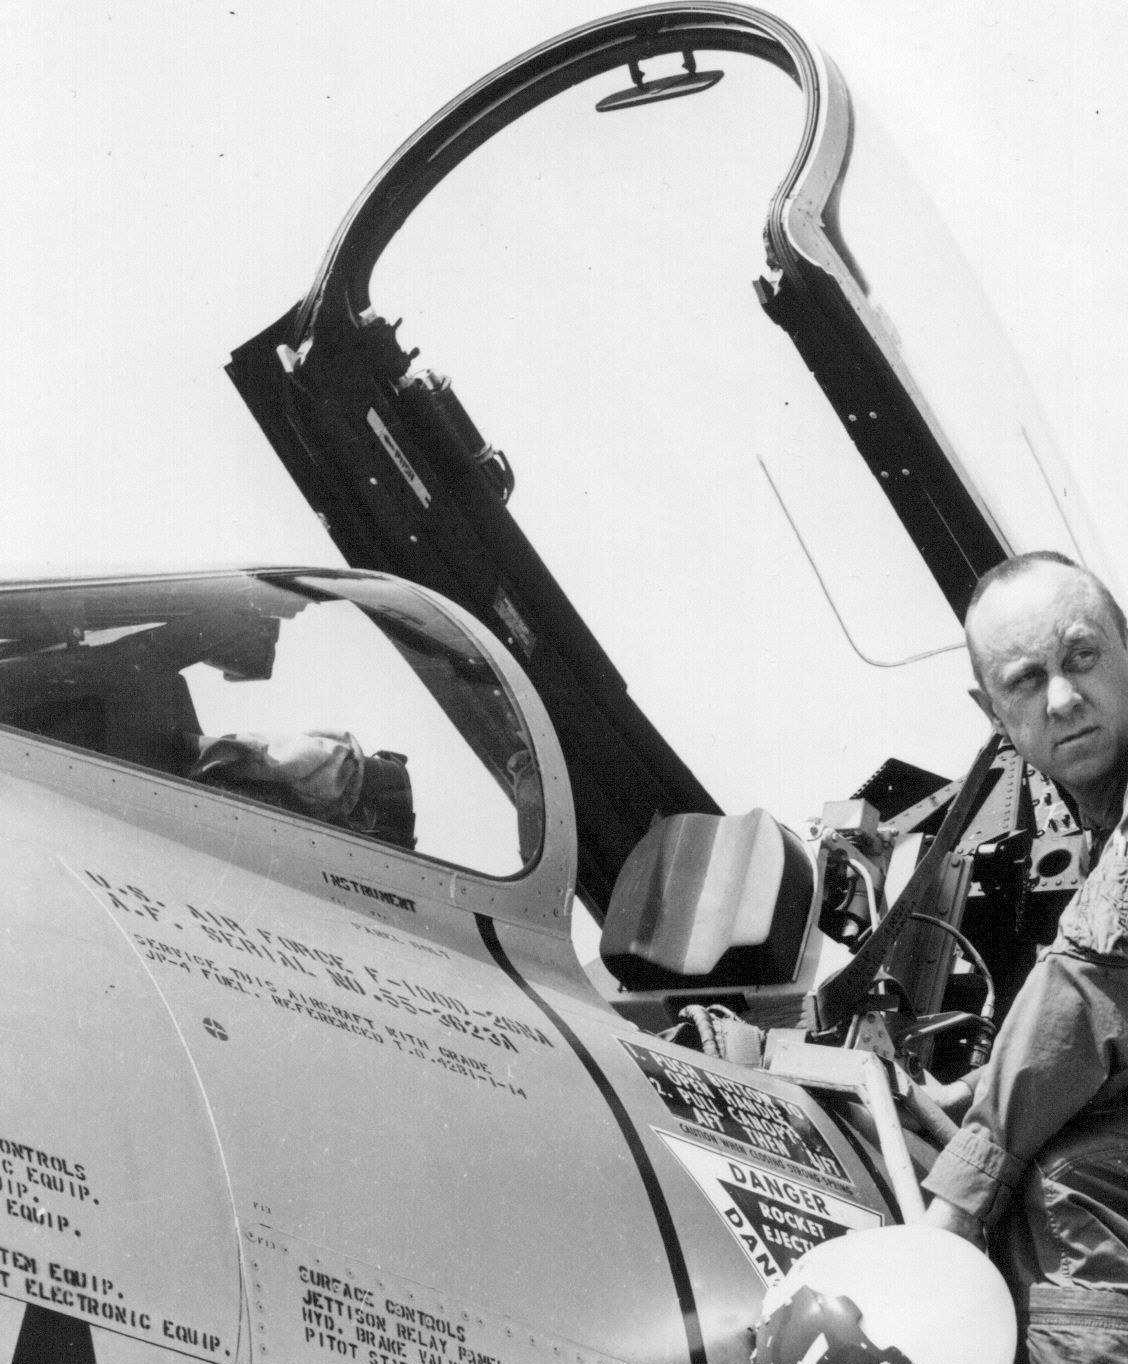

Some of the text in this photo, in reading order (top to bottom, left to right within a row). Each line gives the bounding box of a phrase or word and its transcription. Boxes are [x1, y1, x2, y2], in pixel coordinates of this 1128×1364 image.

[321, 871, 417, 913] INSTRUMENT
[187, 904, 247, 935] AIR
[257, 928, 353, 974] FORCE
[201, 924, 317, 978] SERIAL
[133, 933, 492, 1075] SERVICE THIS AIRCRAFT WITH GRADE
[146, 949, 191, 973] JP-4
[201, 968, 261, 998] FUEL.
[271, 993, 384, 1043] REFERENCED
[648, 1050, 703, 1081] PUSH
[703, 1070, 772, 1106] BUTTON
[777, 1098, 804, 1121] TO
[648, 1077, 674, 1099] 2.
[676, 1090, 724, 1119] PULL
[663, 1067, 786, 1123] OPEN HANDLE
[679, 1122, 719, 1145] CAUTION
[750, 1150, 787, 1172] CLOSING
[788, 1162, 824, 1184] STRONG
[692, 1107, 726, 1133] AFT
[741, 1125, 792, 1159] THEN
[26, 1166, 100, 1206] EQUIP.
[728, 1162, 831, 1217] DANGER
[6, 1198, 82, 1238] EQUIP.
[757, 1201, 827, 1240] ROCKET
[48, 1262, 125, 1300] EQUIP.
[298, 1264, 467, 1344] SURFACE CONTROLS
[25, 1277, 151, 1330] ELECTRONIC
[162, 1319, 232, 1357] EQUIP.
[302, 1289, 387, 1333] JETTISON
[396, 1322, 448, 1355] RELAY
[302, 1306, 344, 1335] HYD.
[355, 1326, 408, 1359] BRAKE
[305, 1325, 359, 1360] PITOT
